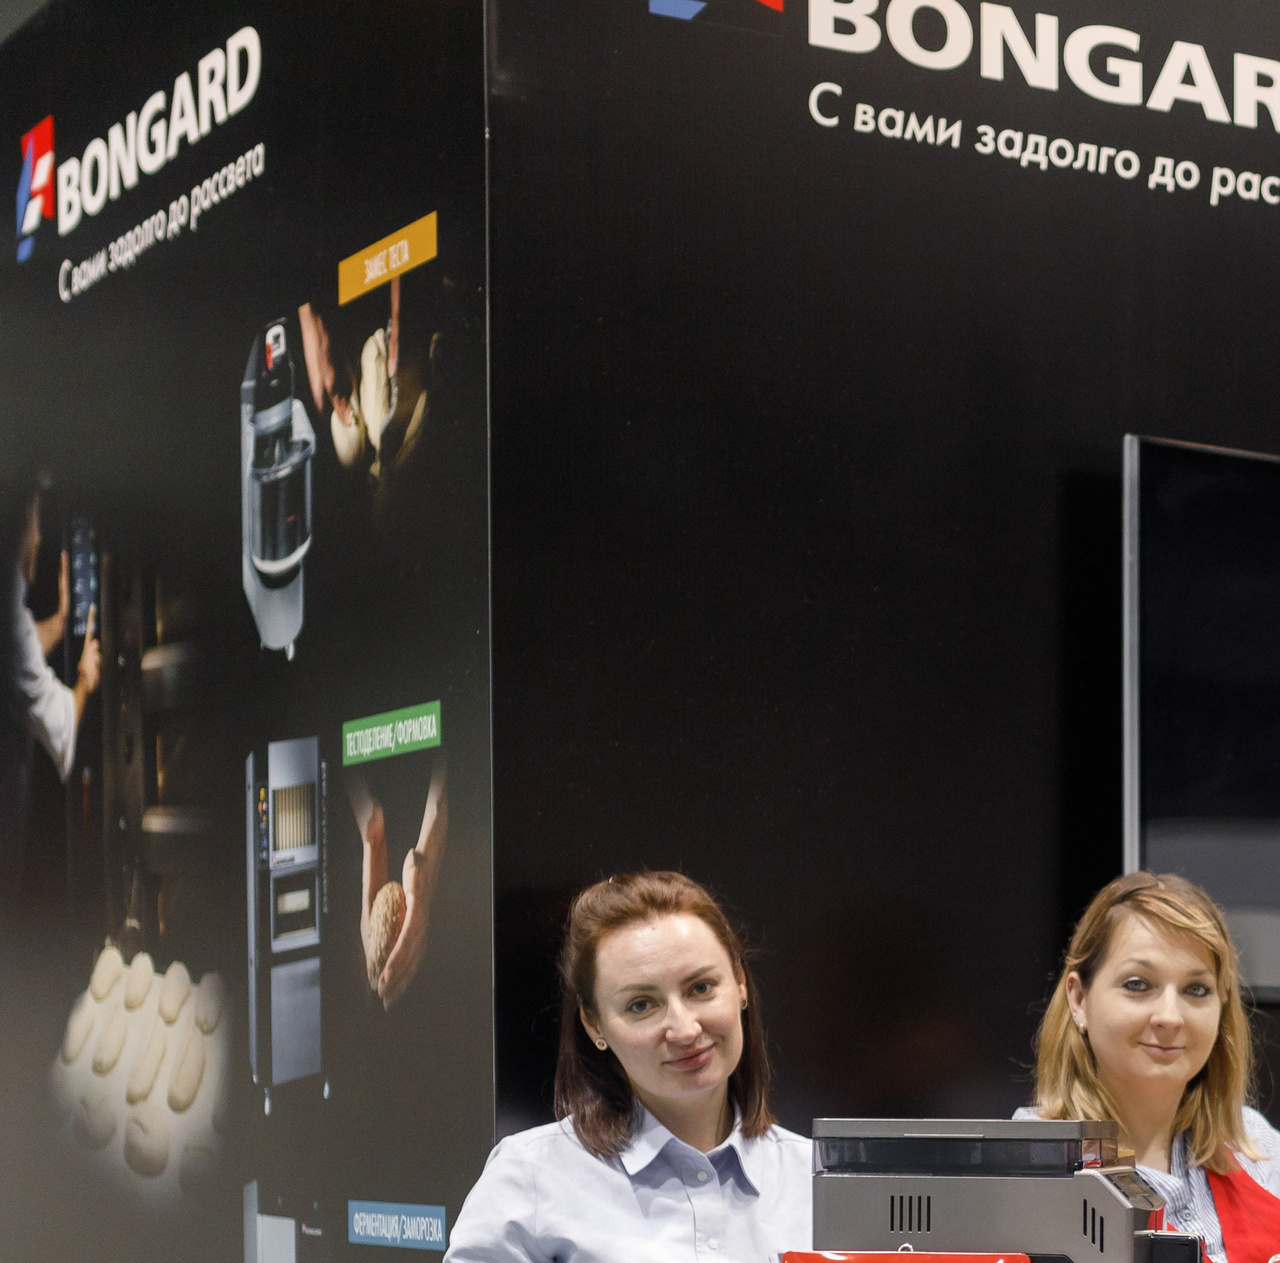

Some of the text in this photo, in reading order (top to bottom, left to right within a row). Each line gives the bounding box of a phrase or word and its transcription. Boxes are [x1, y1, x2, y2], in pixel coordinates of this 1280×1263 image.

[57, 26, 262, 237] BONGARD
[808, 82, 843, 127] С
[853, 103, 962, 149] вами
[975, 123, 1141, 180] задолго
[1148, 154, 1201, 192] до
[73, 256, 107, 297] вами
[107, 208, 167, 276] задолго
[166, 193, 188, 240] до
[188, 142, 266, 231] рассвета
